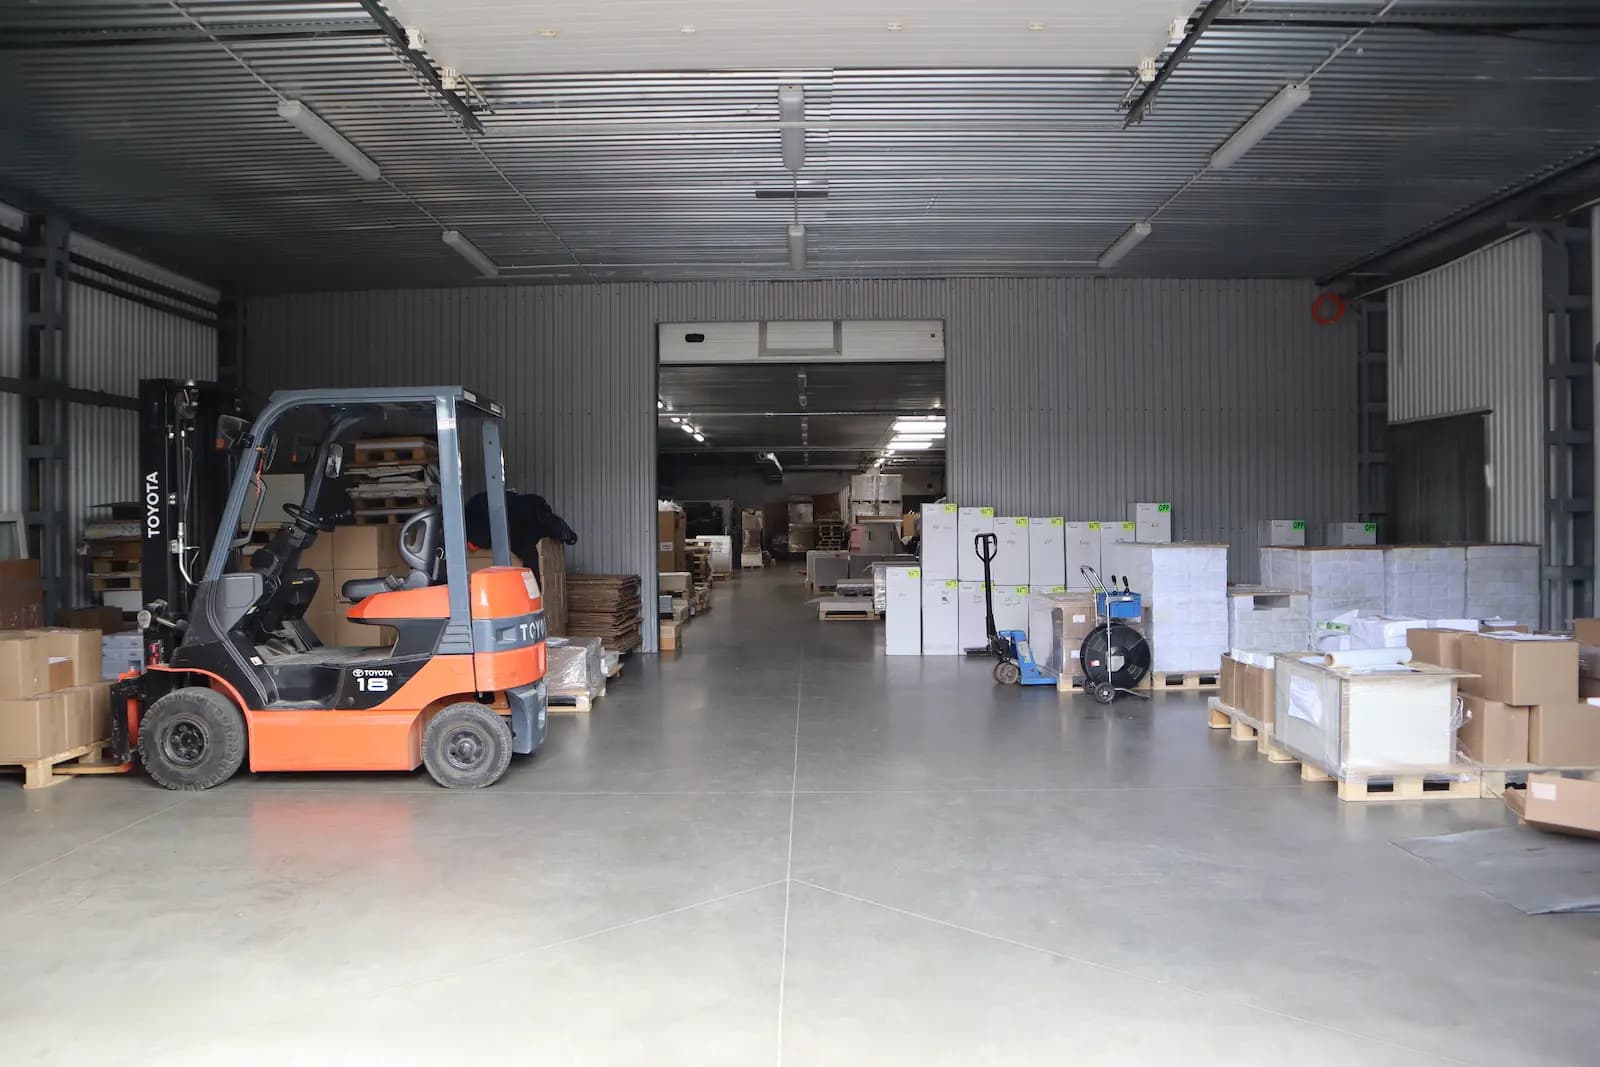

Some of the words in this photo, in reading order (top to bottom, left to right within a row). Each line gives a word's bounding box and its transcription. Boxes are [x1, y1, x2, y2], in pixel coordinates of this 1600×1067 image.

[146, 471, 160, 539] TOYOTA
[519, 617, 547, 641] TOYO
[364, 669, 394, 677] TOYOTA
[356, 677, 389, 692] 18
